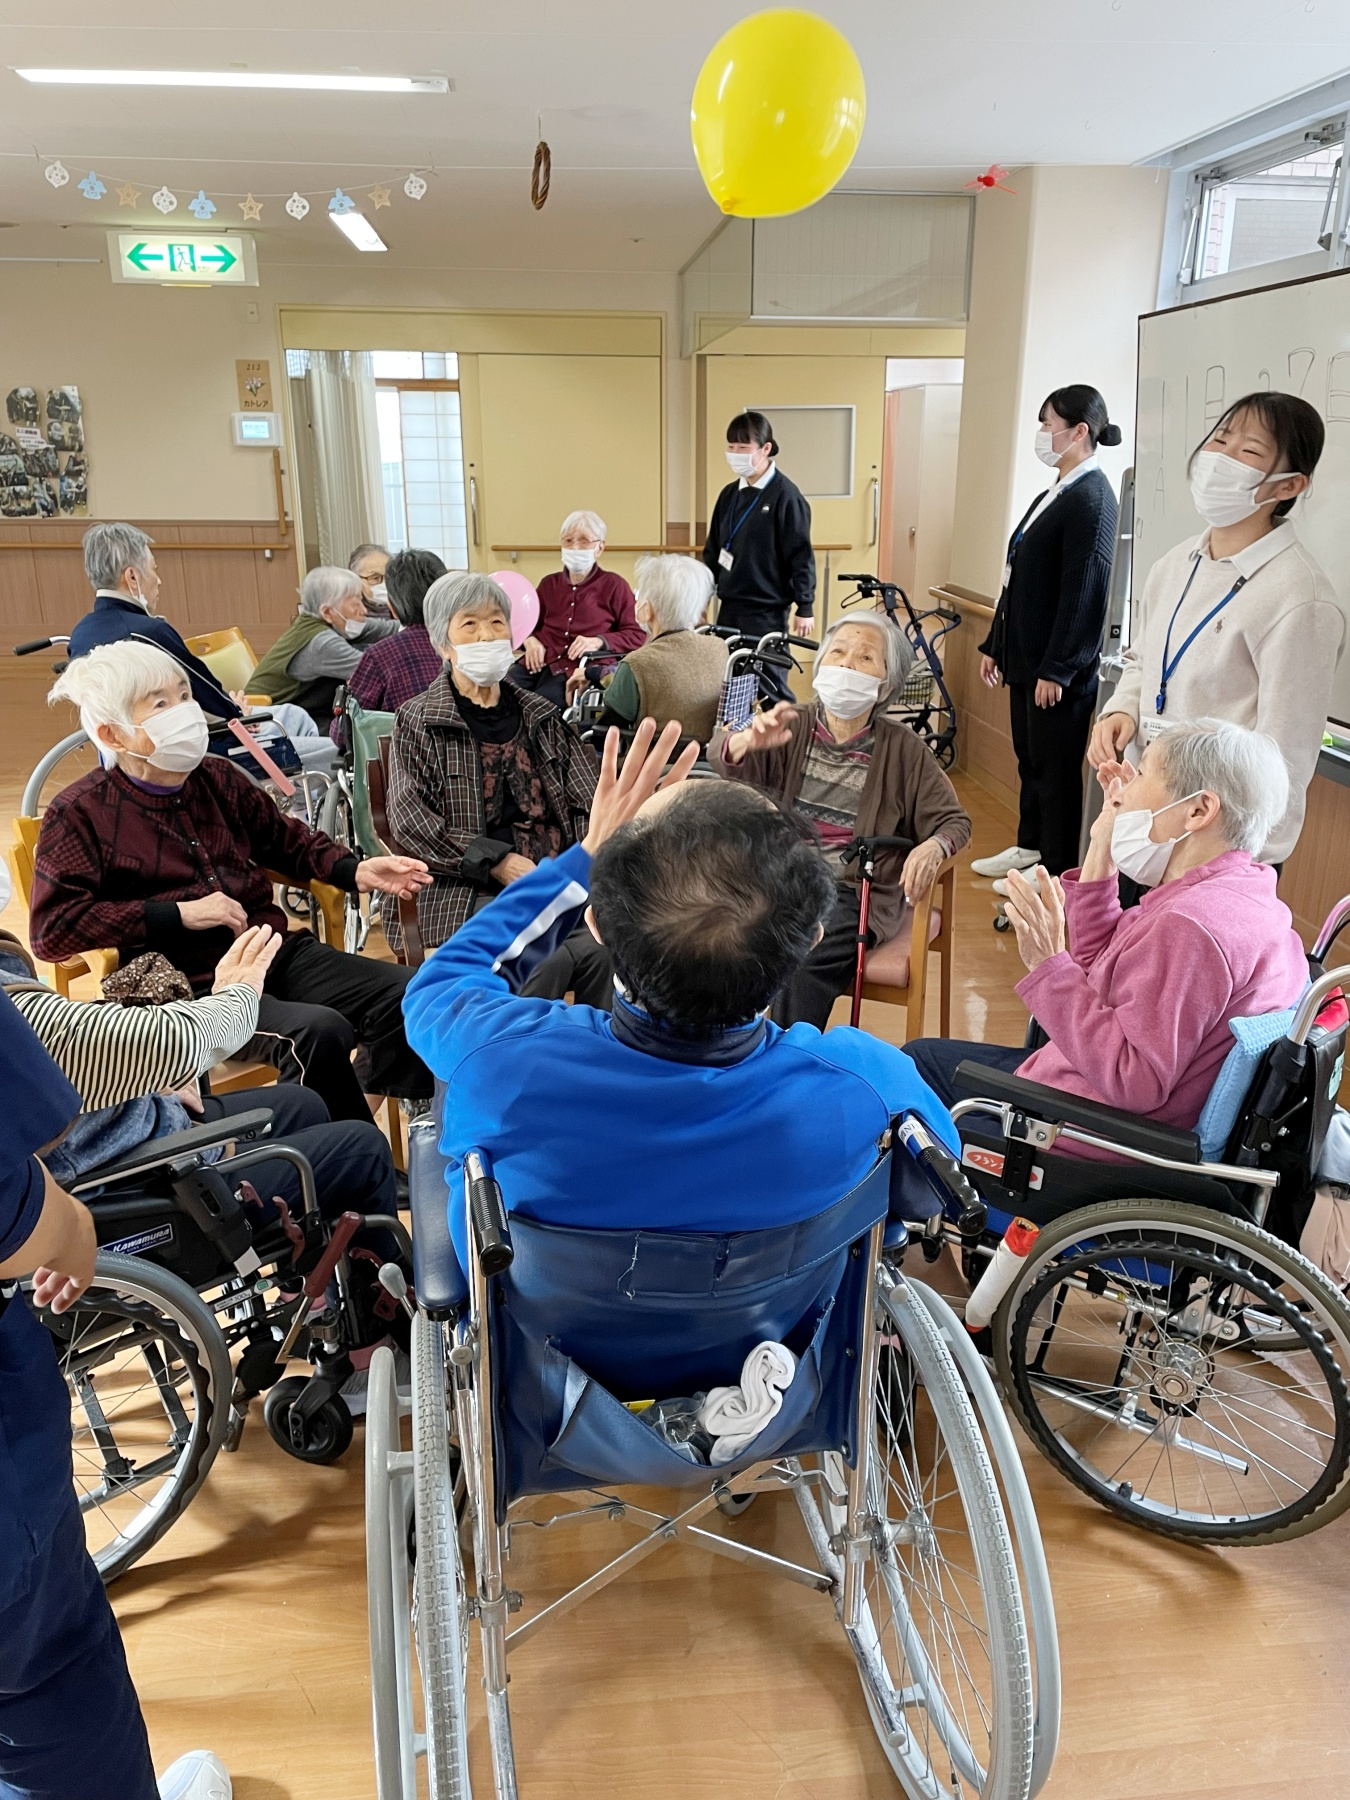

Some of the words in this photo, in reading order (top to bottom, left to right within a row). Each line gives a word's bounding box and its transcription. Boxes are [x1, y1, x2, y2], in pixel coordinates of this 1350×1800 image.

[246, 363, 261, 371] 212
[244, 400, 269, 408] カトレア
[113, 1228, 170, 1253] KAWAMURA
